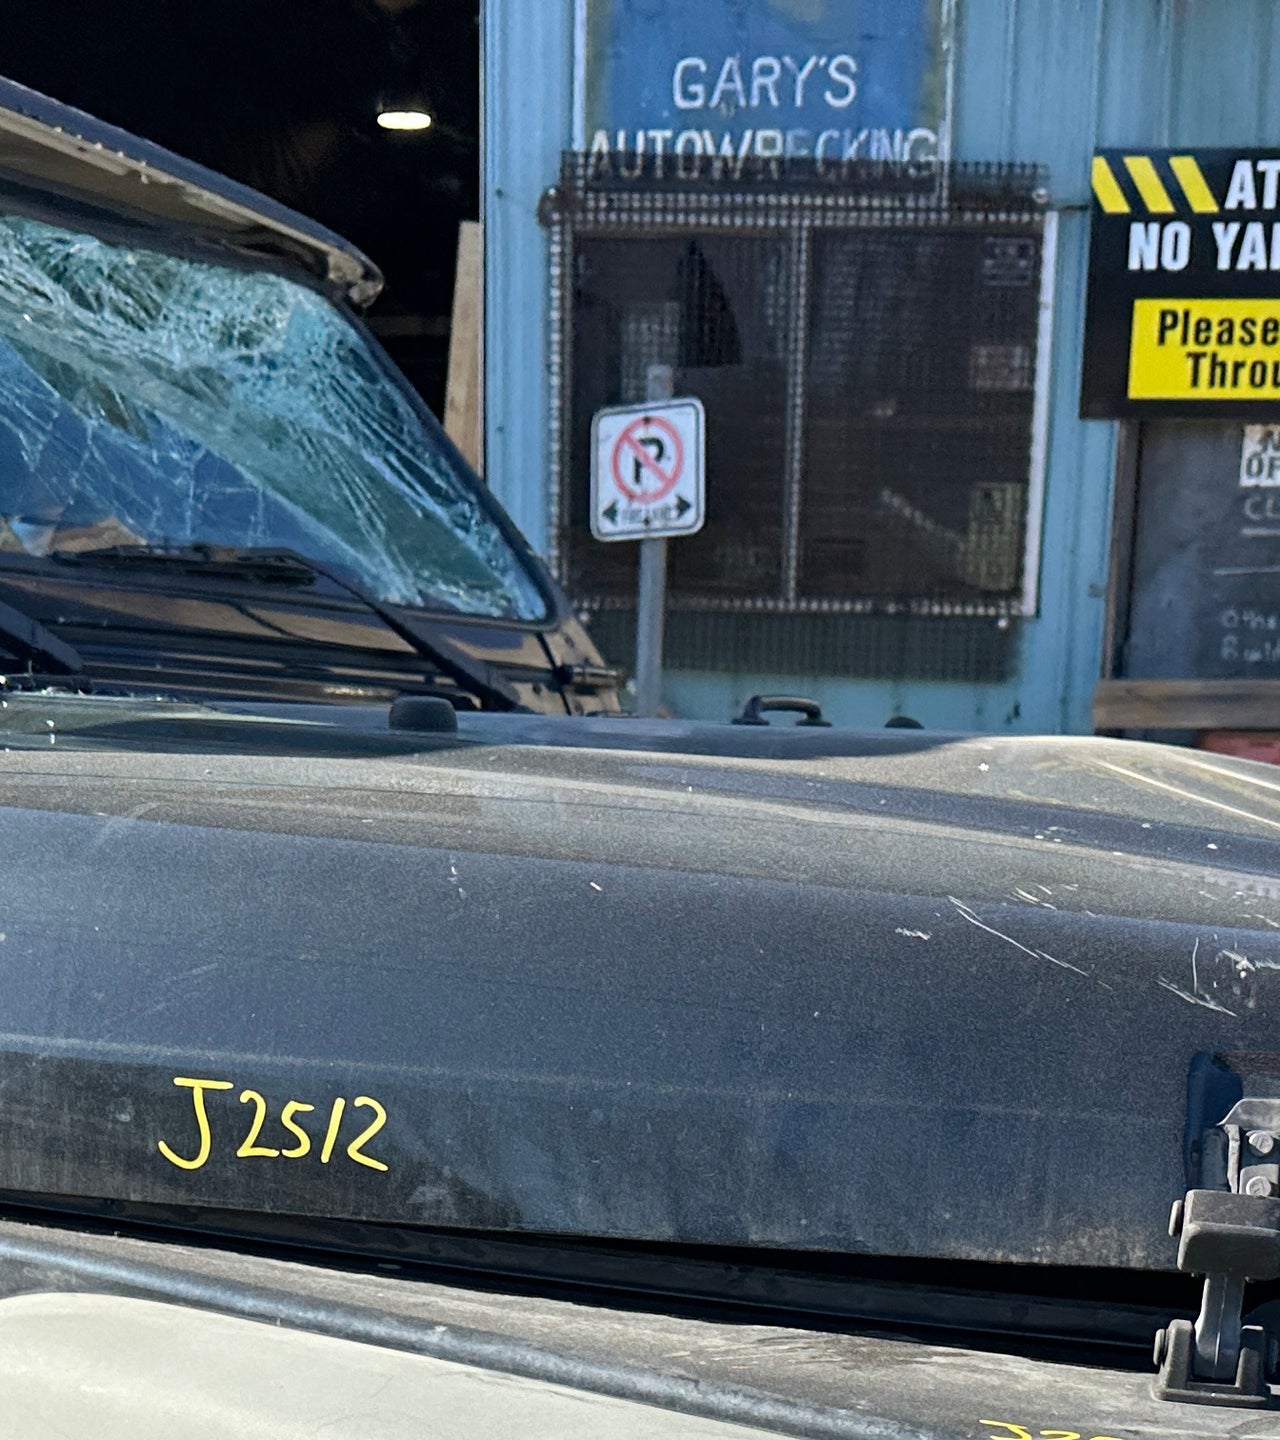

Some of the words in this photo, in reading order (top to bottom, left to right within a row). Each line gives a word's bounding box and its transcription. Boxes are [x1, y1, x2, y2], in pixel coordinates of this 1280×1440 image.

[672, 54, 858, 109] GARY'S
[1128, 222, 1192, 271] NO
[1157, 309, 1280, 347] Please
[158, 1077, 389, 1171] J2512
